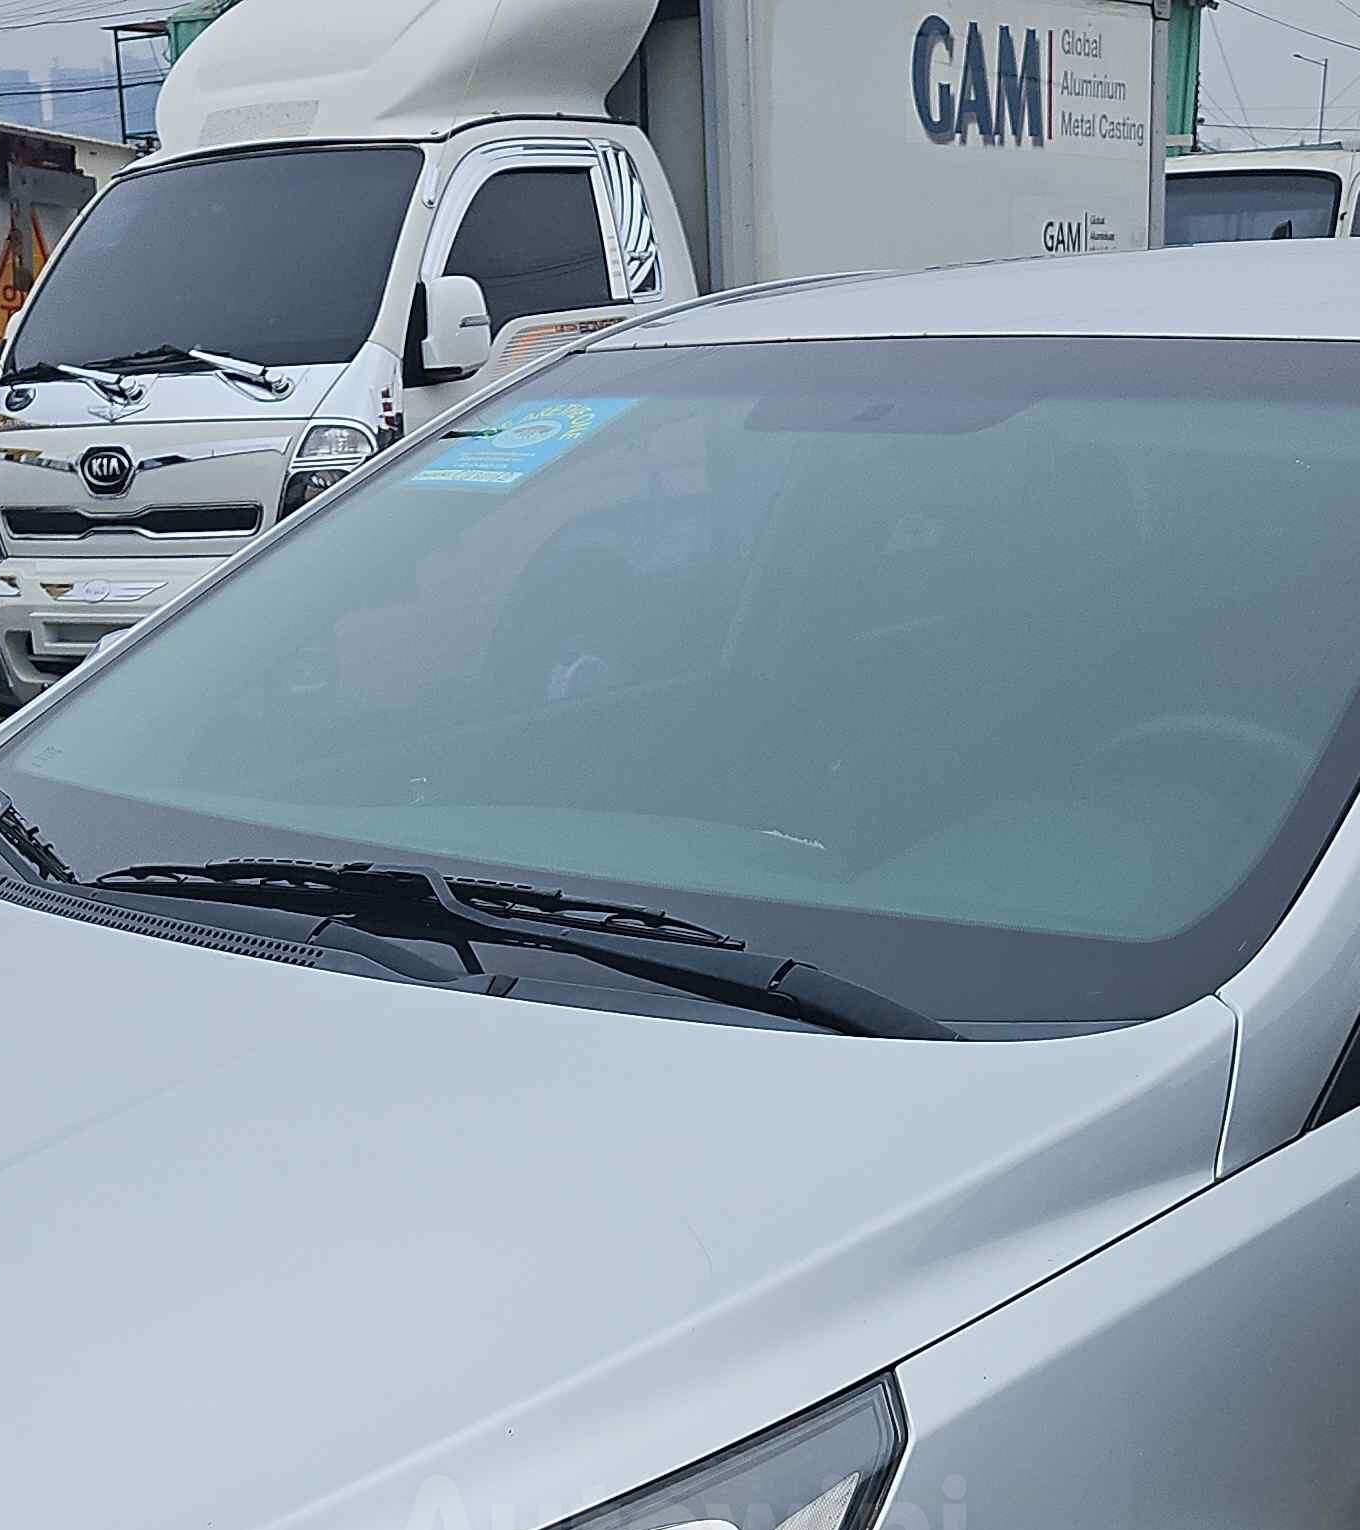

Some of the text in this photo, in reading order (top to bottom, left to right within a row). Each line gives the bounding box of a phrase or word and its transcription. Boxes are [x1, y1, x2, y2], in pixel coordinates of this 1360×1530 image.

[1061, 29, 1102, 58] Global
[913, 15, 1043, 146] GAM
[1060, 71, 1126, 100] Aluminium
[1060, 111, 1144, 146] Metal Casting
[1043, 221, 1081, 252] GAM
[92, 458, 120, 476] KIA
